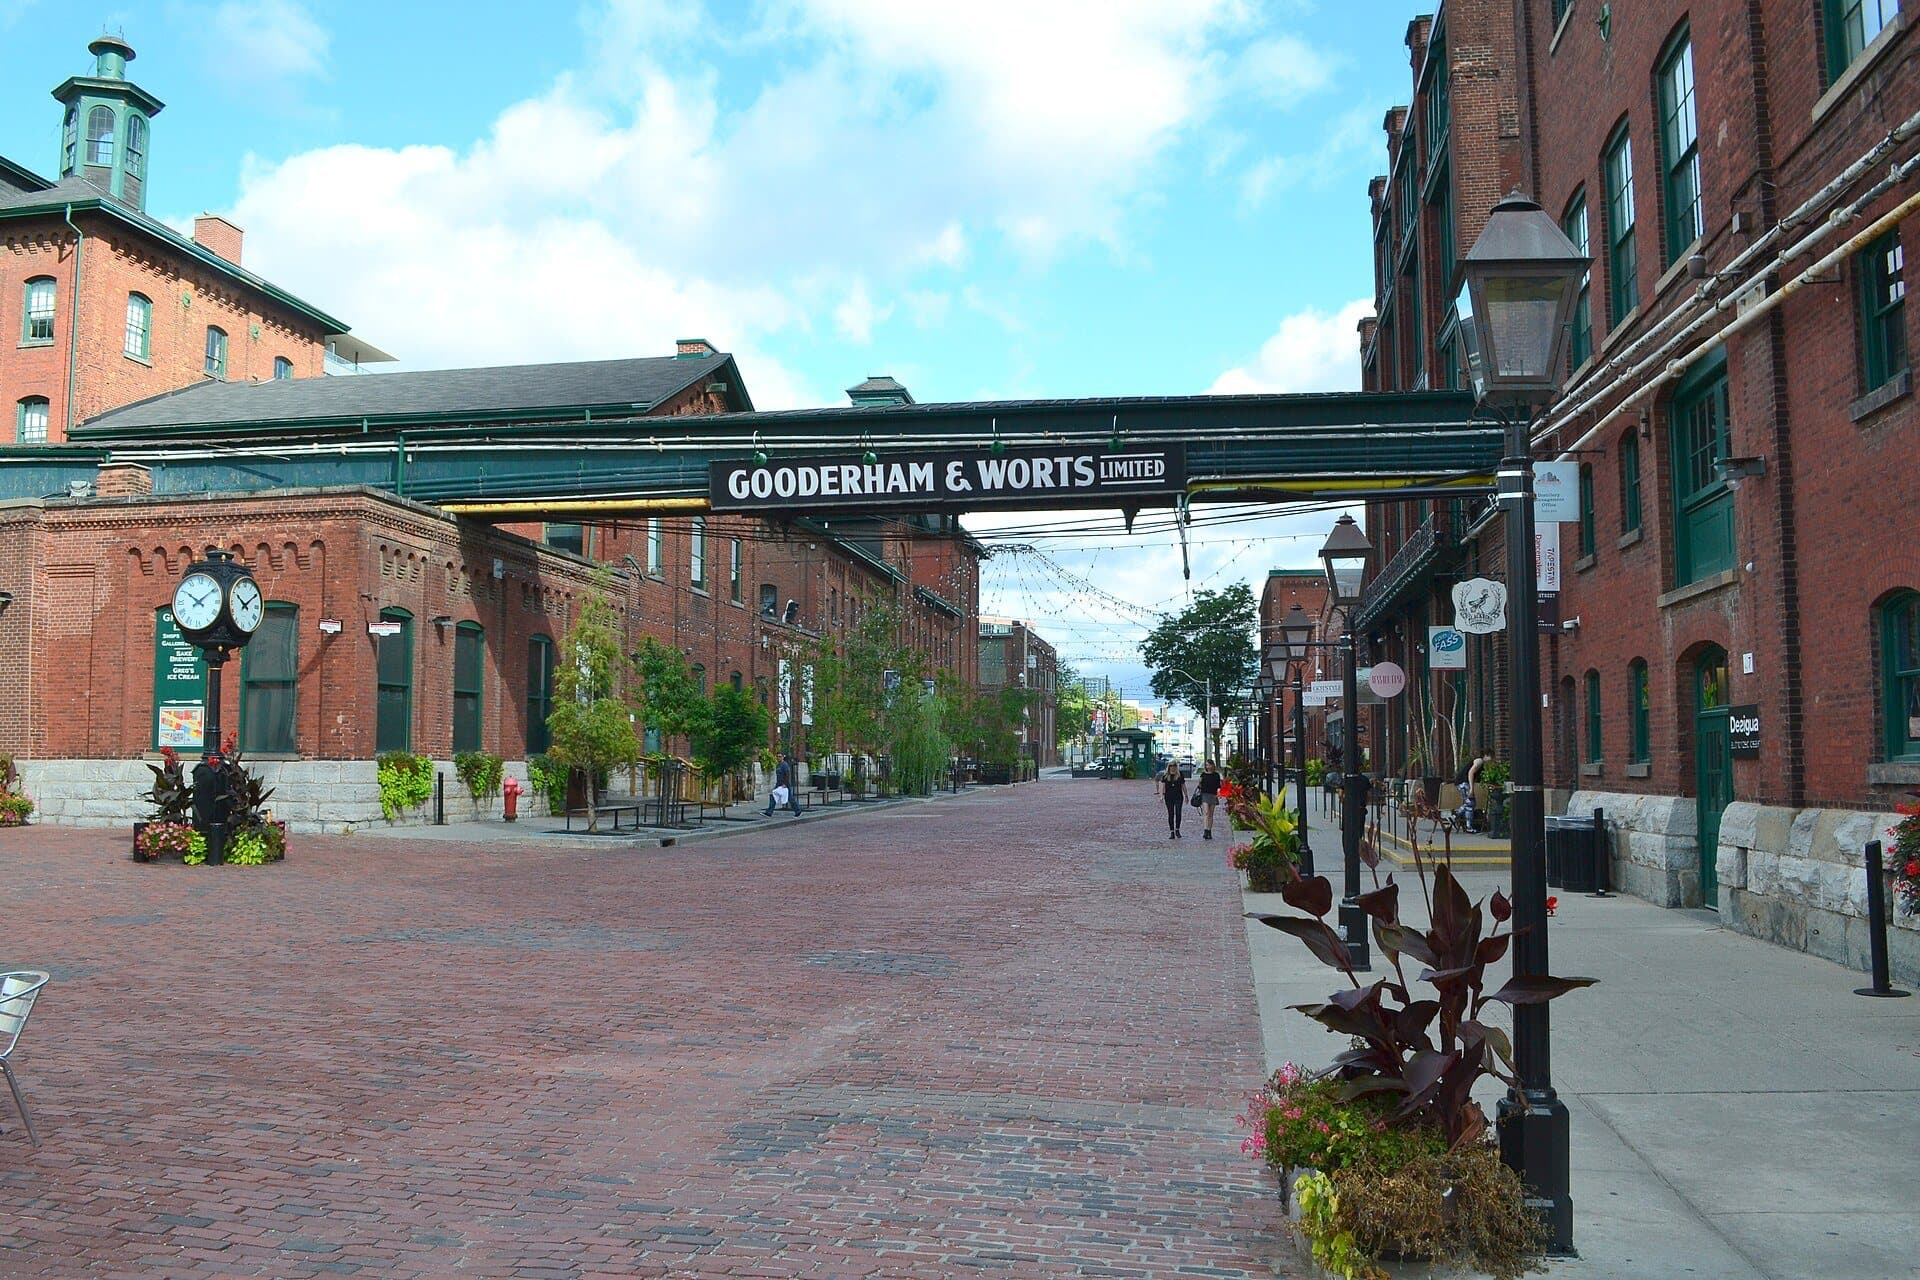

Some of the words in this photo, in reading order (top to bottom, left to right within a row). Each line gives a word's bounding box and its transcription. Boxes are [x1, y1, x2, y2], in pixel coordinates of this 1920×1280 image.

[728, 462, 935, 499] GOODERHAM
[945, 461, 973, 491] &
[976, 456, 1095, 490] WORTS
[1100, 460, 1166, 479] LIMITED
[1435, 634, 1458, 651] FASS
